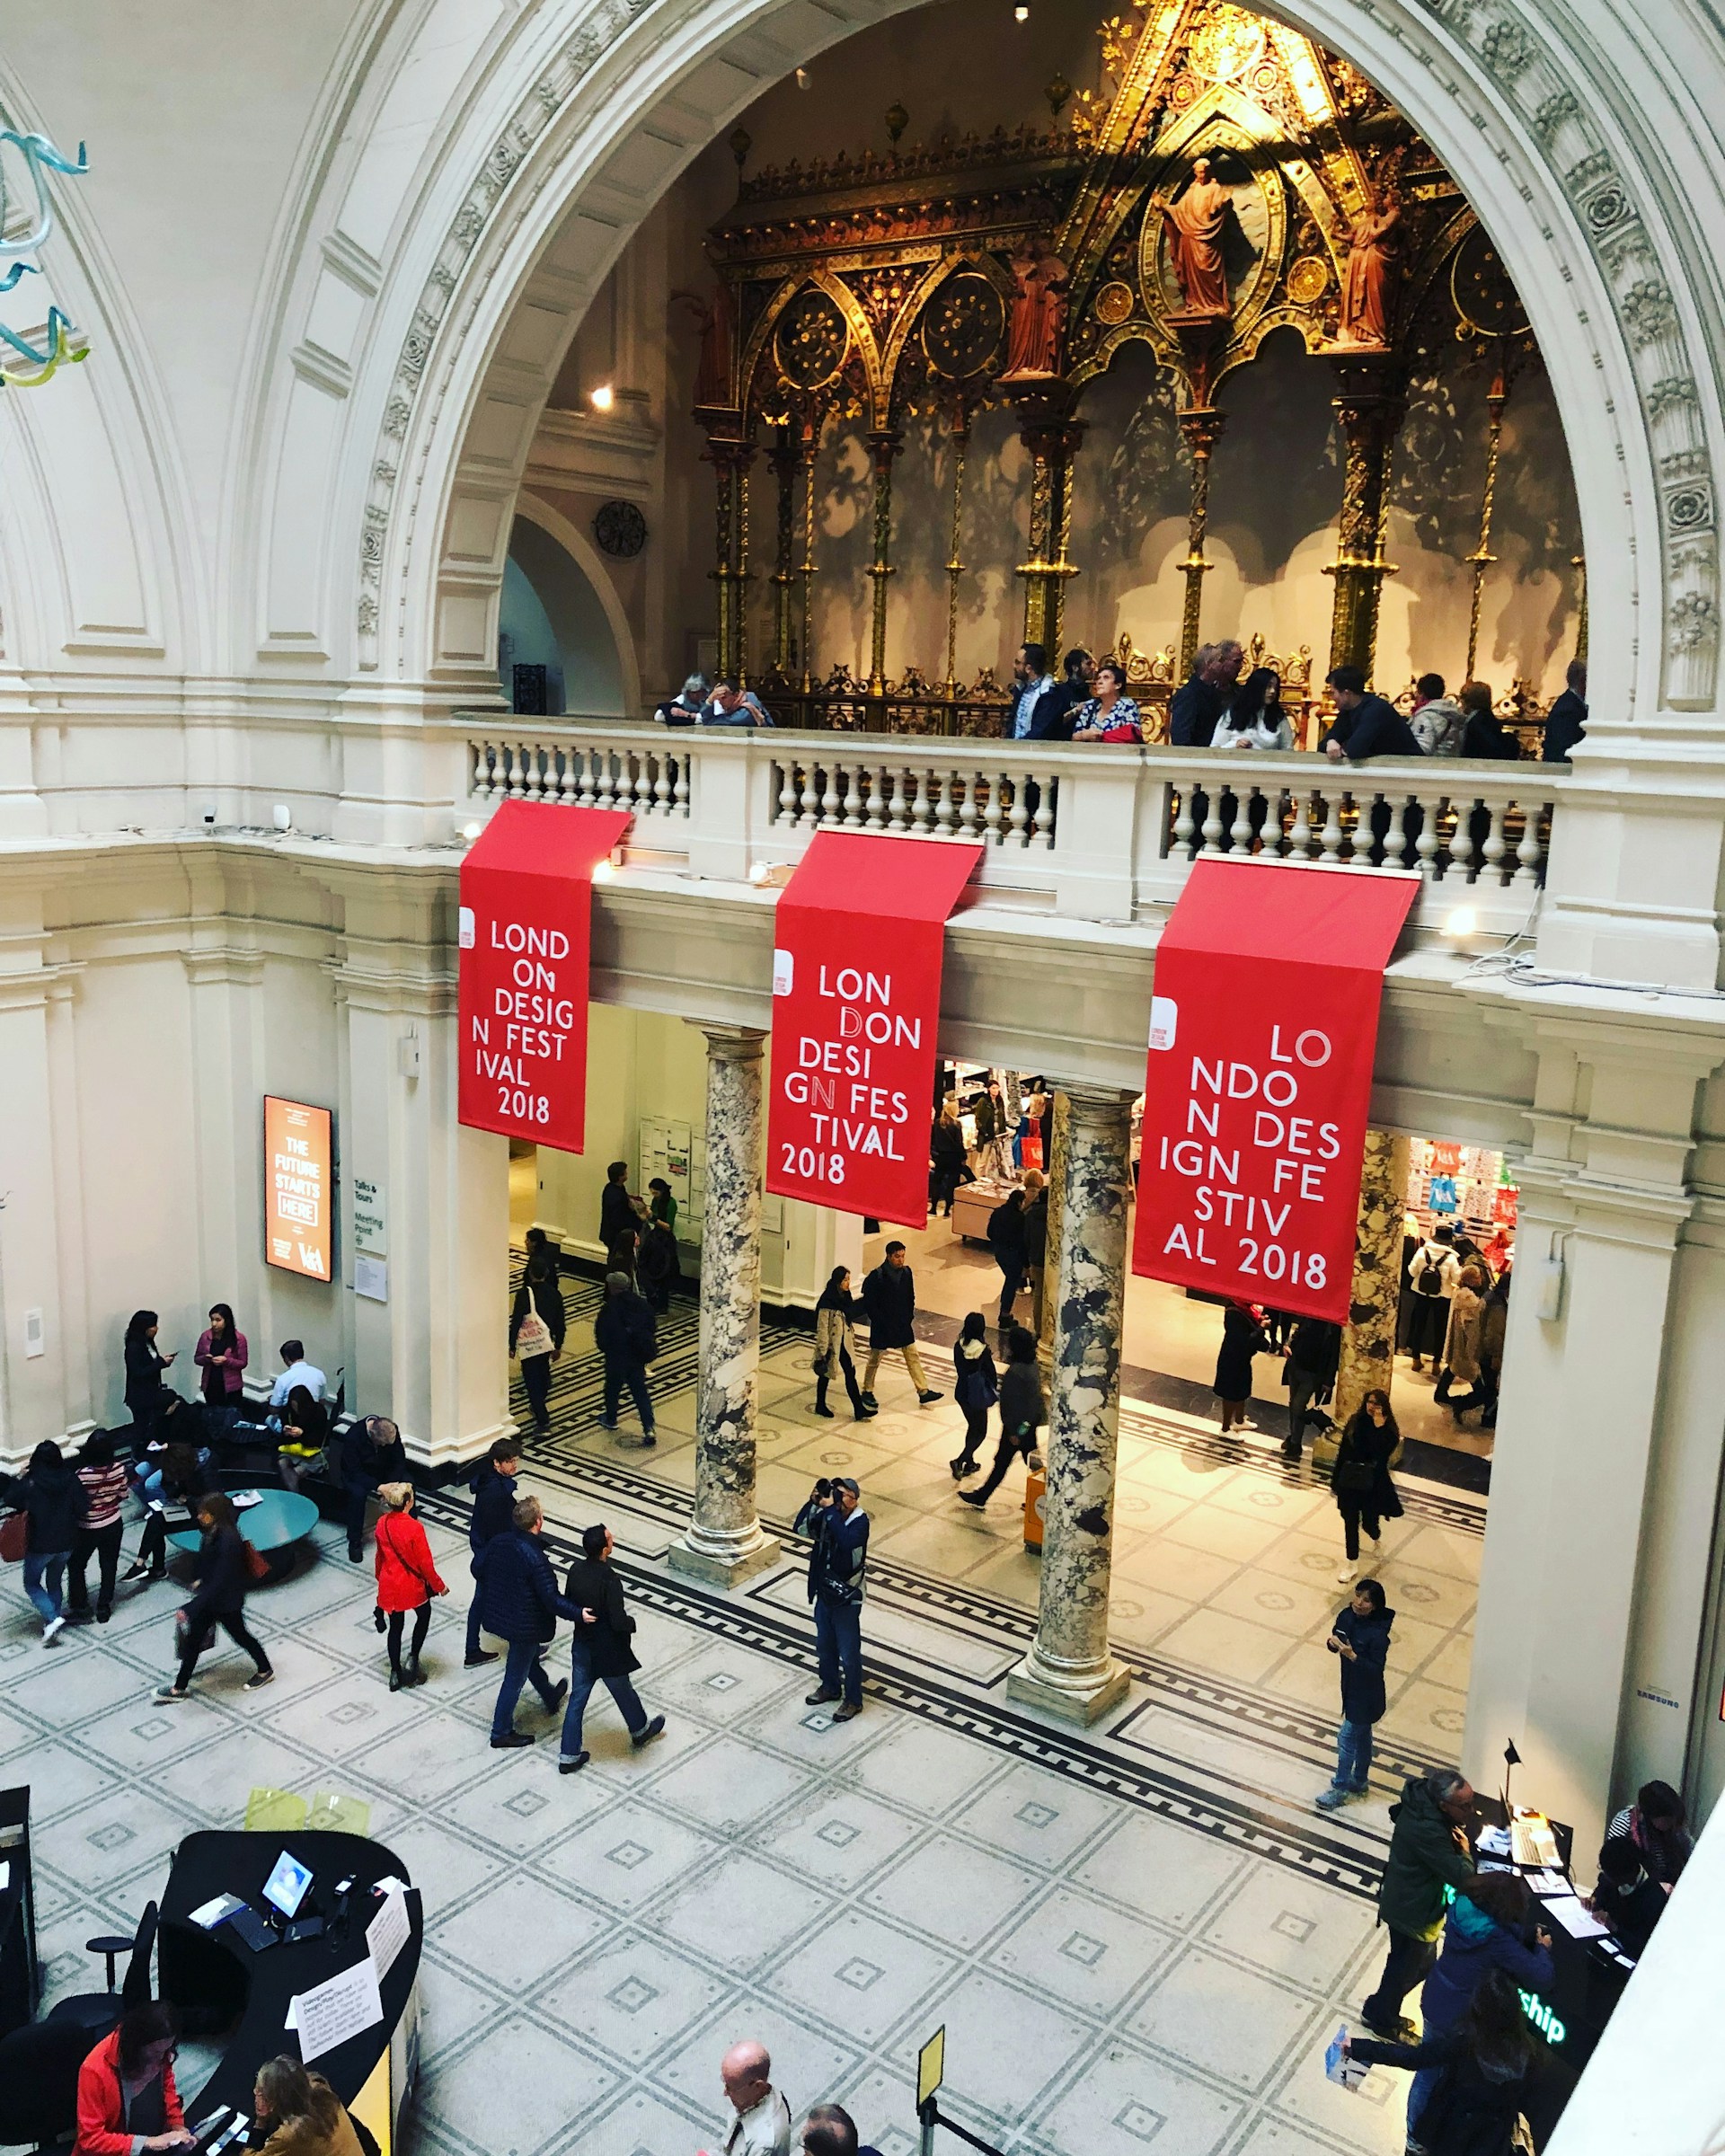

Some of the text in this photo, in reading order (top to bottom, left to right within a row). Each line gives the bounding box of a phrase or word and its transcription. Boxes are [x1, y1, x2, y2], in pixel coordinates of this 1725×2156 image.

[491, 920, 570, 959] LOND
[512, 959, 555, 992] ON
[818, 965, 891, 1006] LON
[495, 988, 573, 1029] DESIG
[840, 1006, 921, 1049] DON
[473, 1015, 567, 1061] N FEST
[799, 1036, 871, 1079] DESI
[1270, 1024, 1331, 1067] LO
[476, 1049, 530, 1087] IVAL
[1190, 1056, 1298, 1108] NDO
[498, 1087, 550, 1124] 2018
[783, 1072, 908, 1124] GN FES
[286, 1136, 309, 1157] THE
[809, 1112, 905, 1162] TIVAL
[1187, 1099, 1340, 1159] N DES
[275, 1153, 320, 1180] FUTURE
[781, 1143, 845, 1185] 2018
[1159, 1136, 1326, 1202] IGN FE
[275, 1173, 321, 1199] STARTS
[354, 1180, 370, 1192] Talks
[354, 1190, 373, 1204] Tours
[282, 1197, 314, 1221] HERE
[355, 1212, 384, 1231] Meeting
[1193, 1185, 1291, 1237] STIV
[355, 1224, 373, 1236] Point
[1163, 1224, 1326, 1290] AL 2018
[1636, 1689, 1679, 1709] SAMSUNG
[1517, 1988, 1566, 2045] ship
